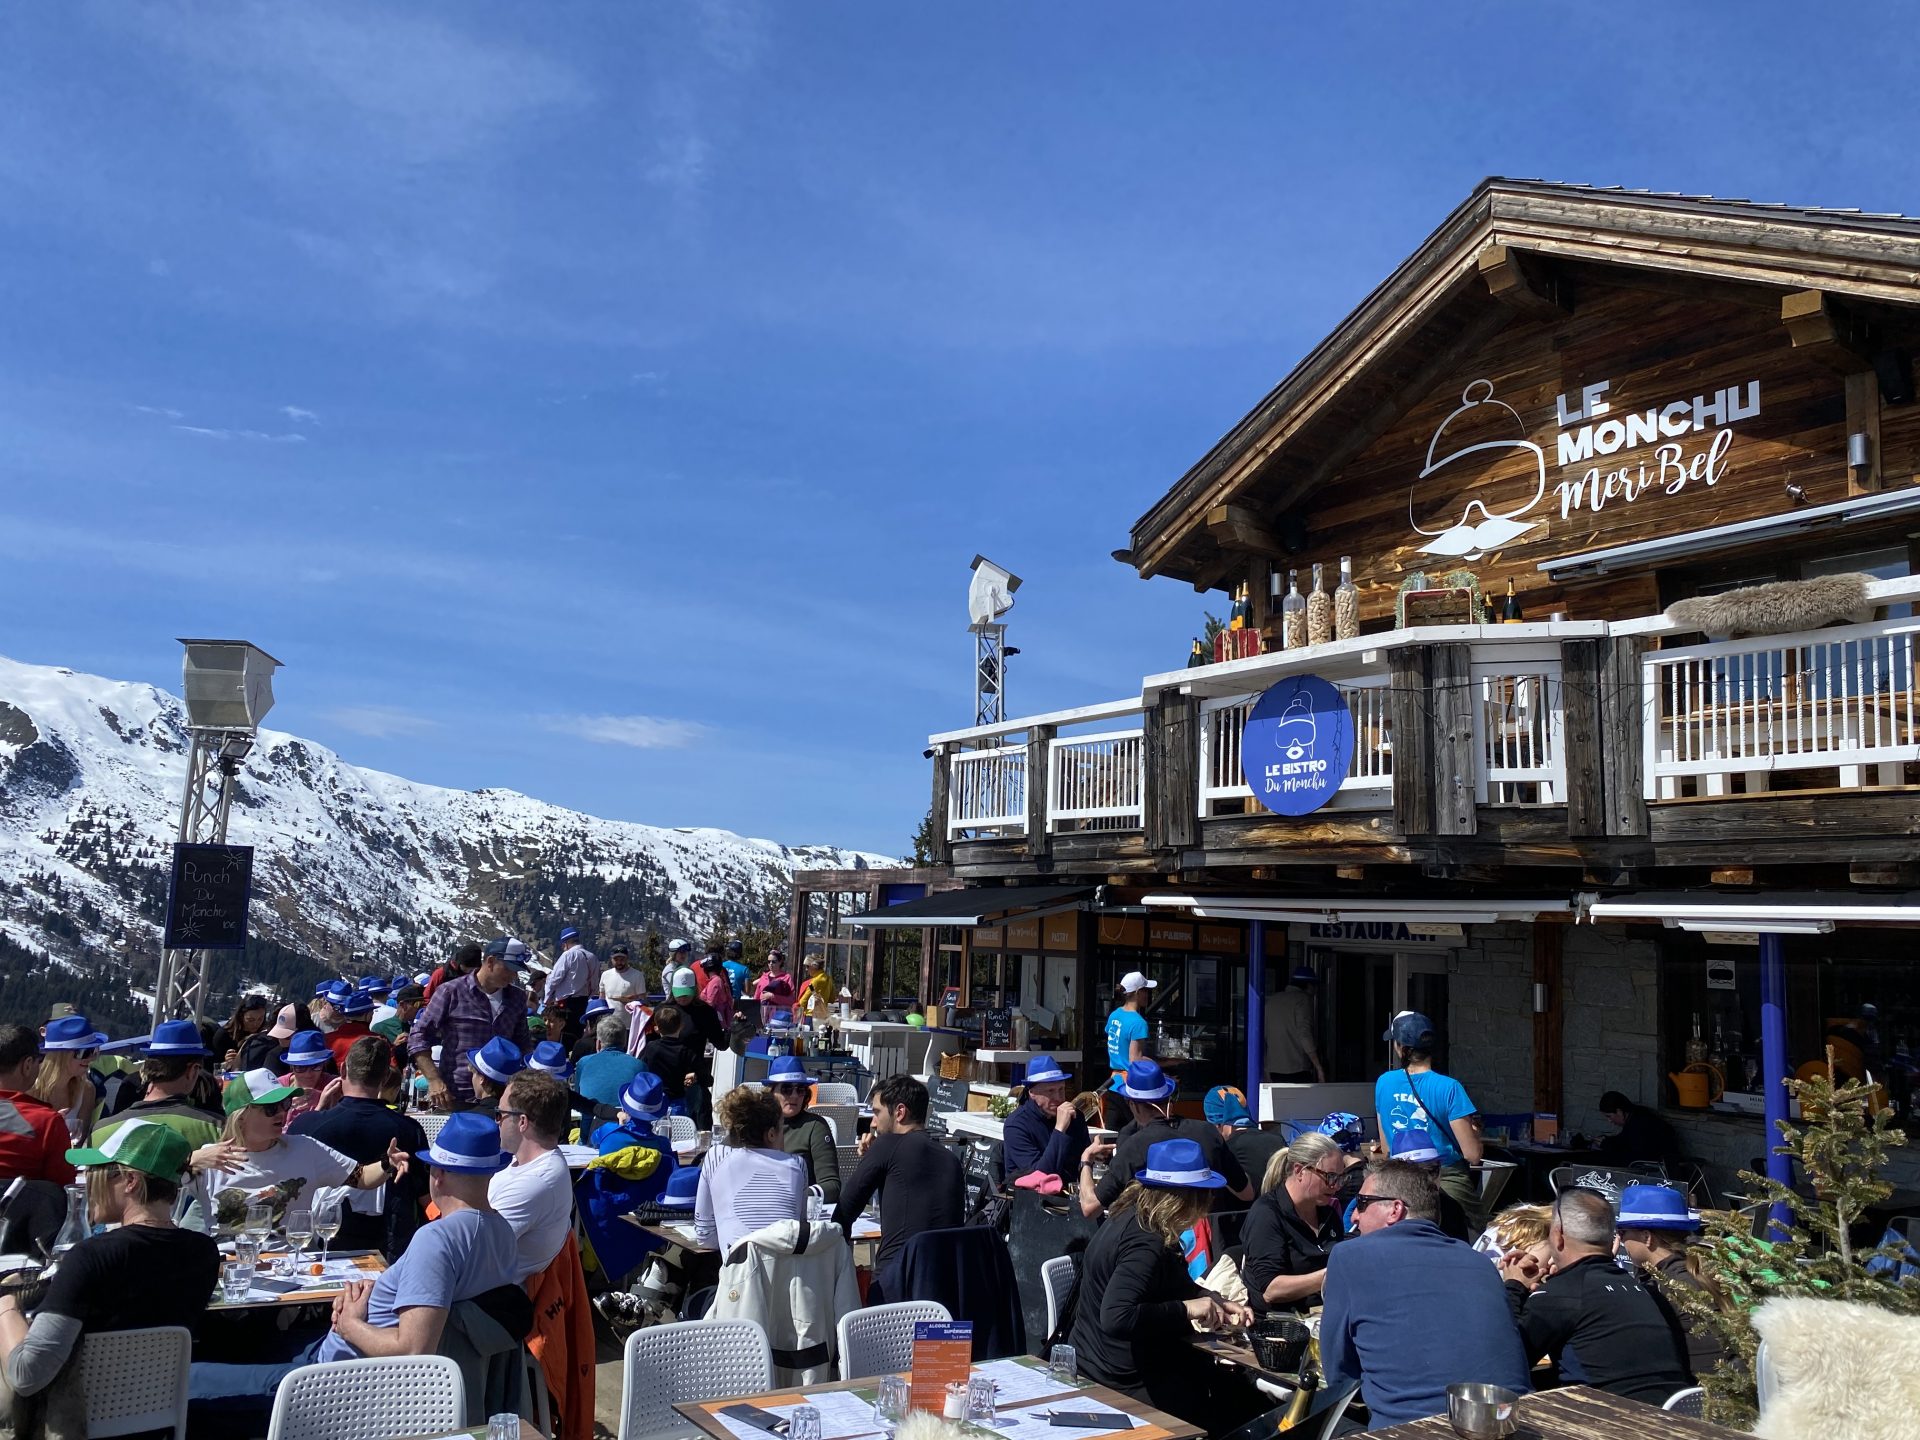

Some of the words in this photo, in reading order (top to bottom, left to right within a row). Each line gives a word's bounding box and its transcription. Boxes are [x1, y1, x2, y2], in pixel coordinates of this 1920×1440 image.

[1556, 380, 1610, 427] LE
[1557, 379, 1761, 467] MONCHU
[1265, 764, 1280, 777] LE
[1282, 759, 1328, 775] BISTRO
[1264, 778, 1282, 793] Du
[1282, 772, 1328, 793] Monchu
[184, 861, 230, 884] Punch
[192, 887, 215, 901] Du
[1149, 929, 1162, 939] LA
[988, 1011, 1008, 1020] Punch
